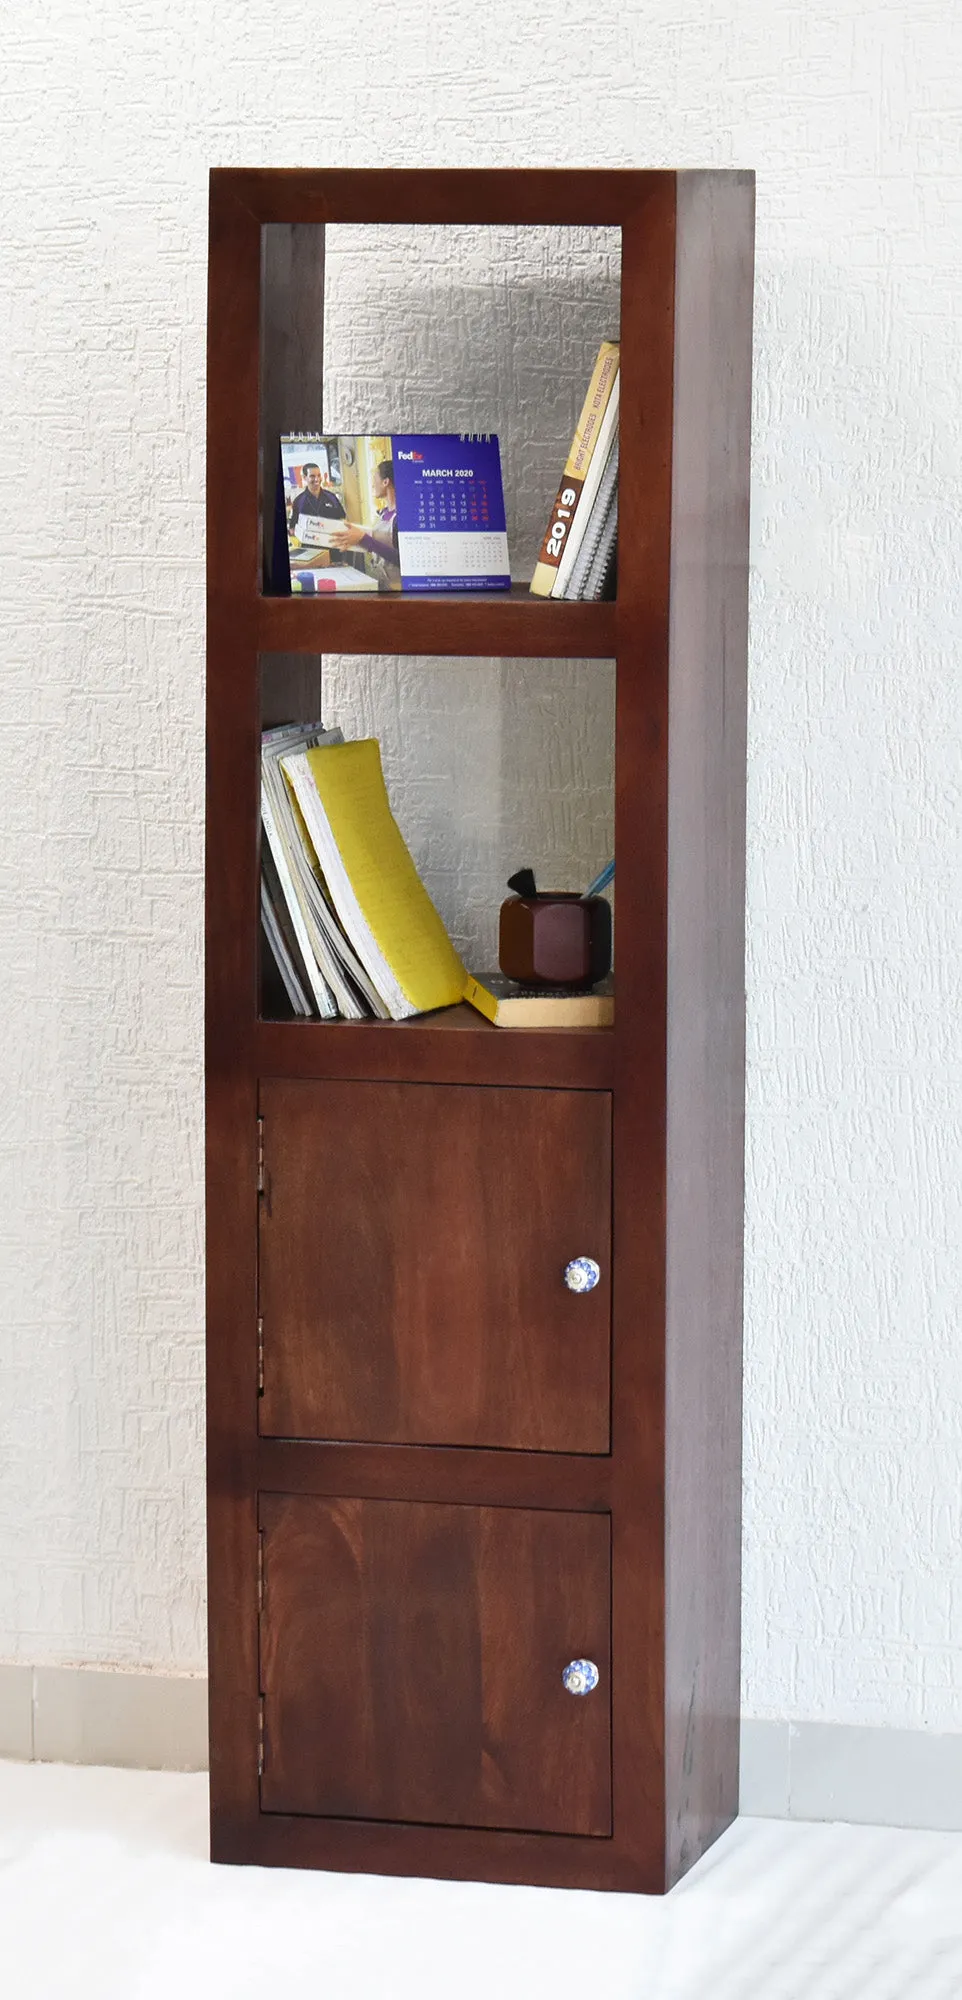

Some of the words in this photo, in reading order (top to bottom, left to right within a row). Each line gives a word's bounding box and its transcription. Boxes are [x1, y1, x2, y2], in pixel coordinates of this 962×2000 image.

[597, 356, 614, 395] ELECTRODES
[593, 392, 603, 410] KOTA
[398, 451, 424, 460] FedEx
[573, 449, 585, 471] BRIGHT
[580, 413, 597, 449] ELECTRODES
[422, 469, 453, 477] MARCH
[455, 469, 474, 477] 2020
[546, 487, 577, 557] 2019
